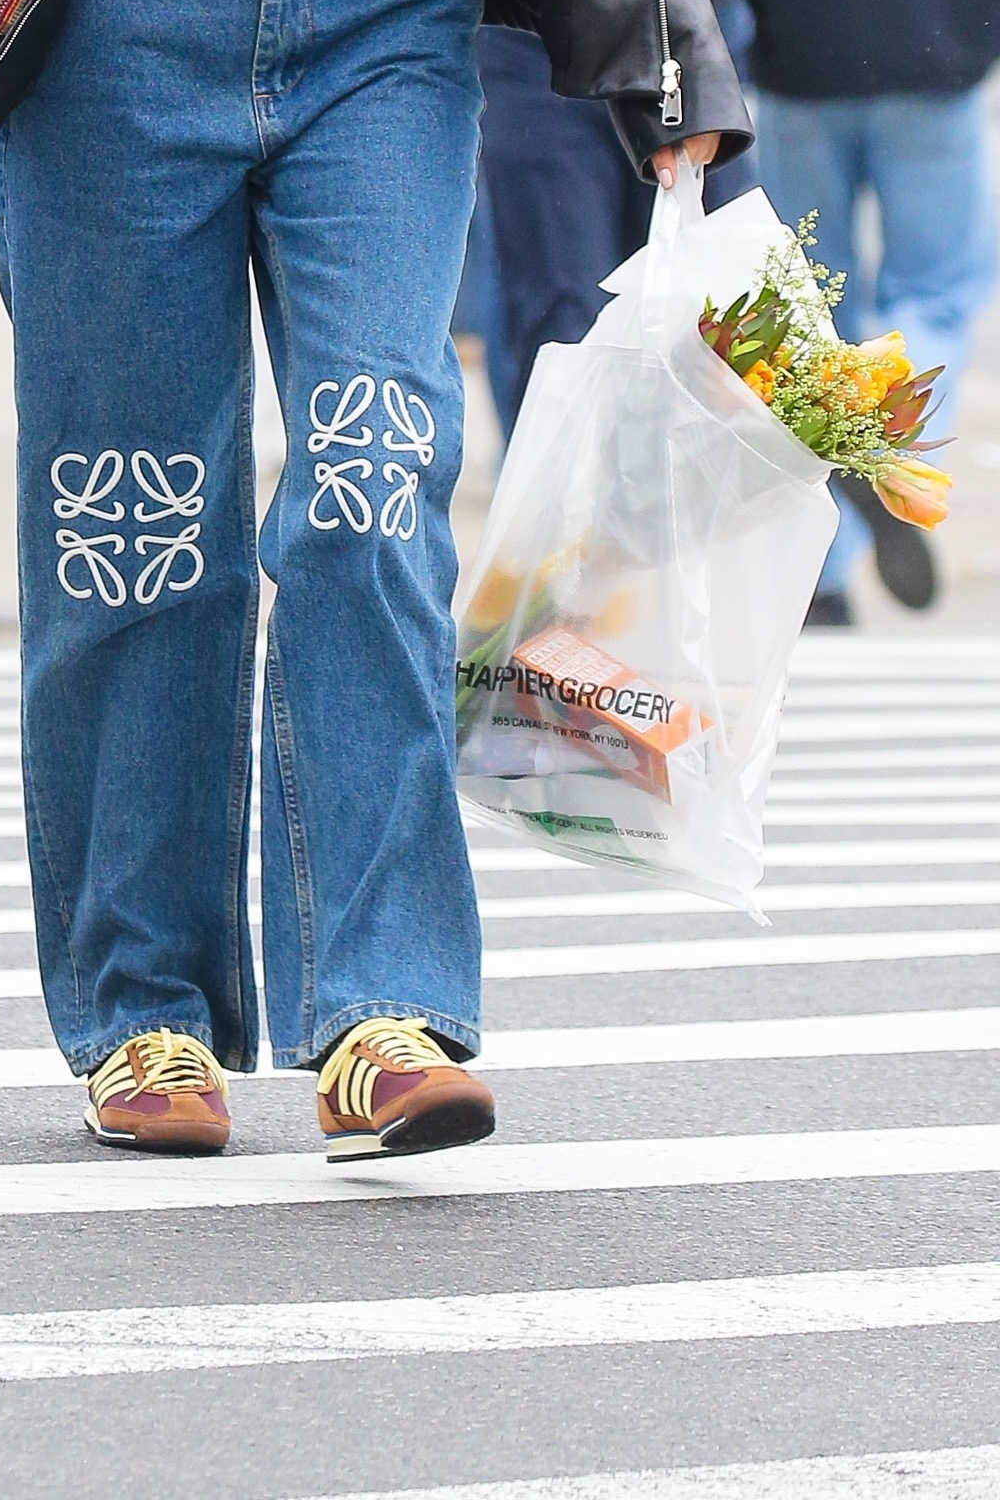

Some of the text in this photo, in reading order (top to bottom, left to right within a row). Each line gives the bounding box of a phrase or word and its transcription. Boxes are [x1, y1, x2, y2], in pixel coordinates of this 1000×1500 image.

[456, 660, 677, 724] HAPPIER GROCERY
[625, 828, 669, 841] RESERVED
